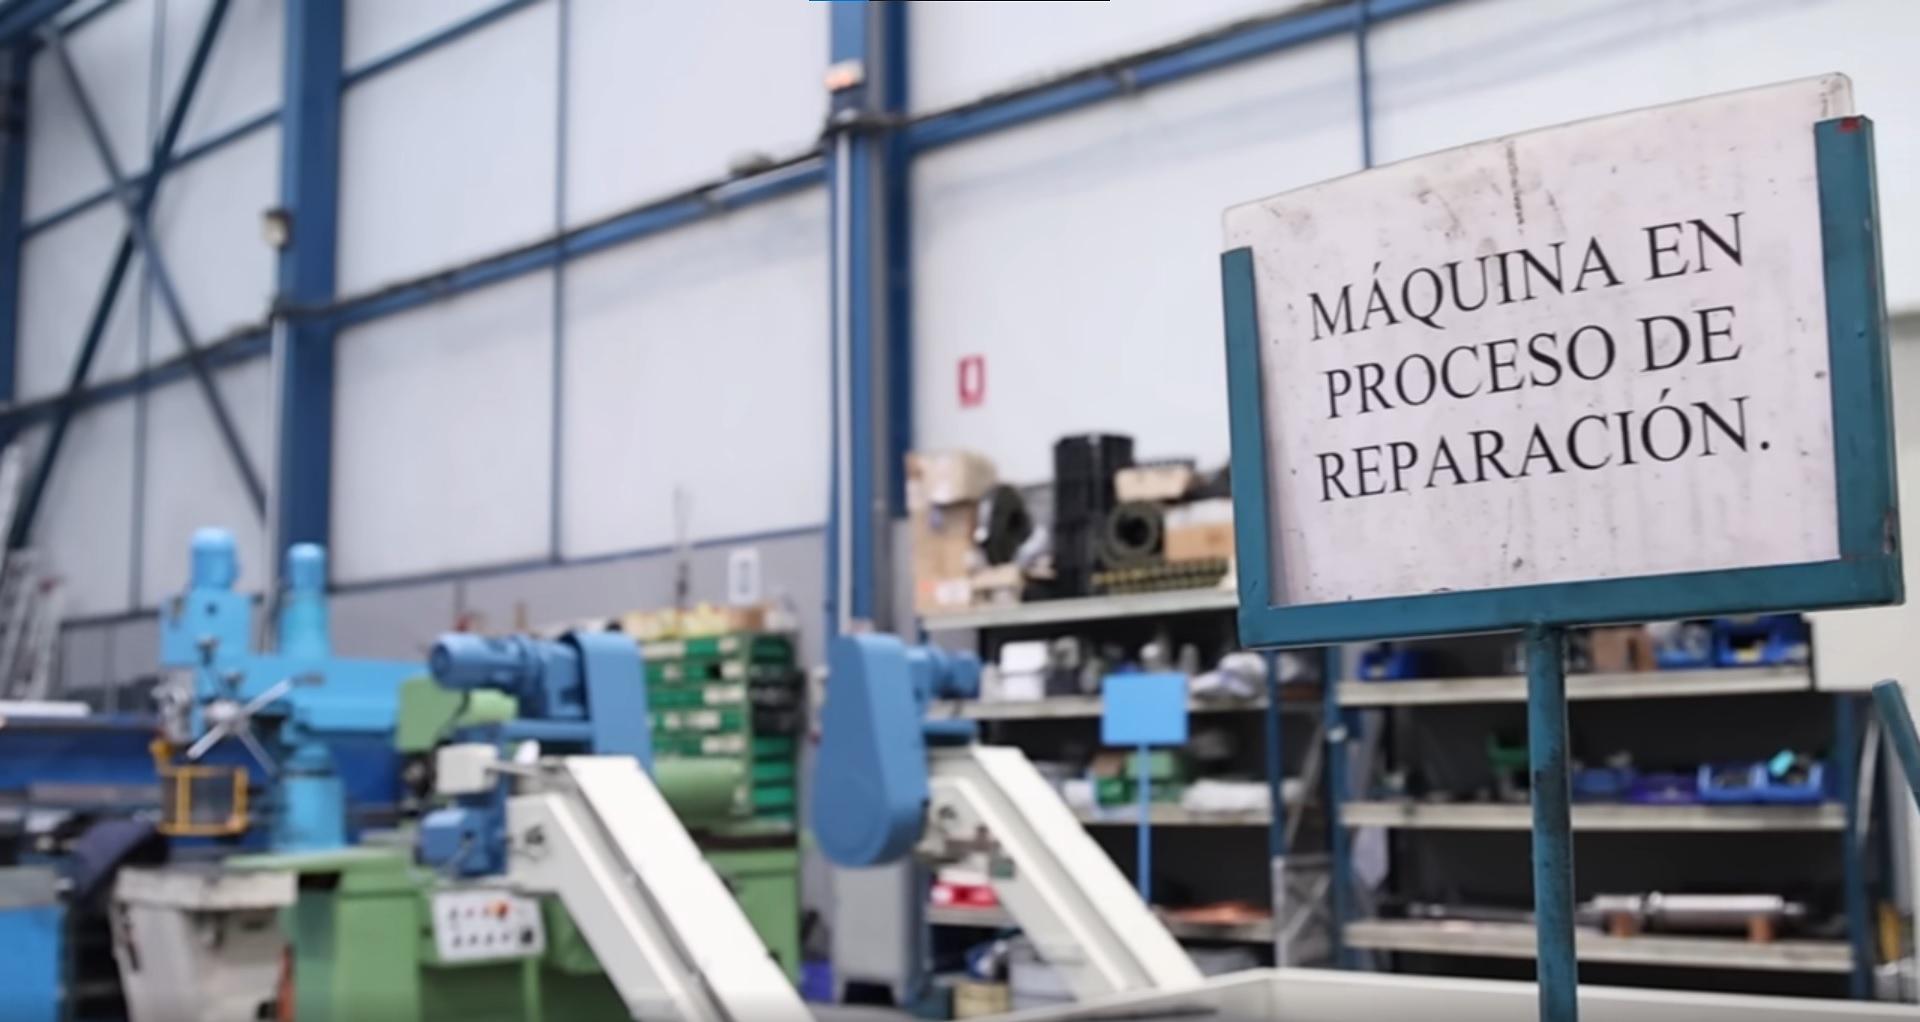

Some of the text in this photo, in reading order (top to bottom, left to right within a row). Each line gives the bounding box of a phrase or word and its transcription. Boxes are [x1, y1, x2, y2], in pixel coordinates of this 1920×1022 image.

[1308, 212, 1746, 340] MÁQUINA EN
[1324, 305, 1742, 419] PROCESO DE
[1315, 388, 1771, 502] REPARACIÓN.
